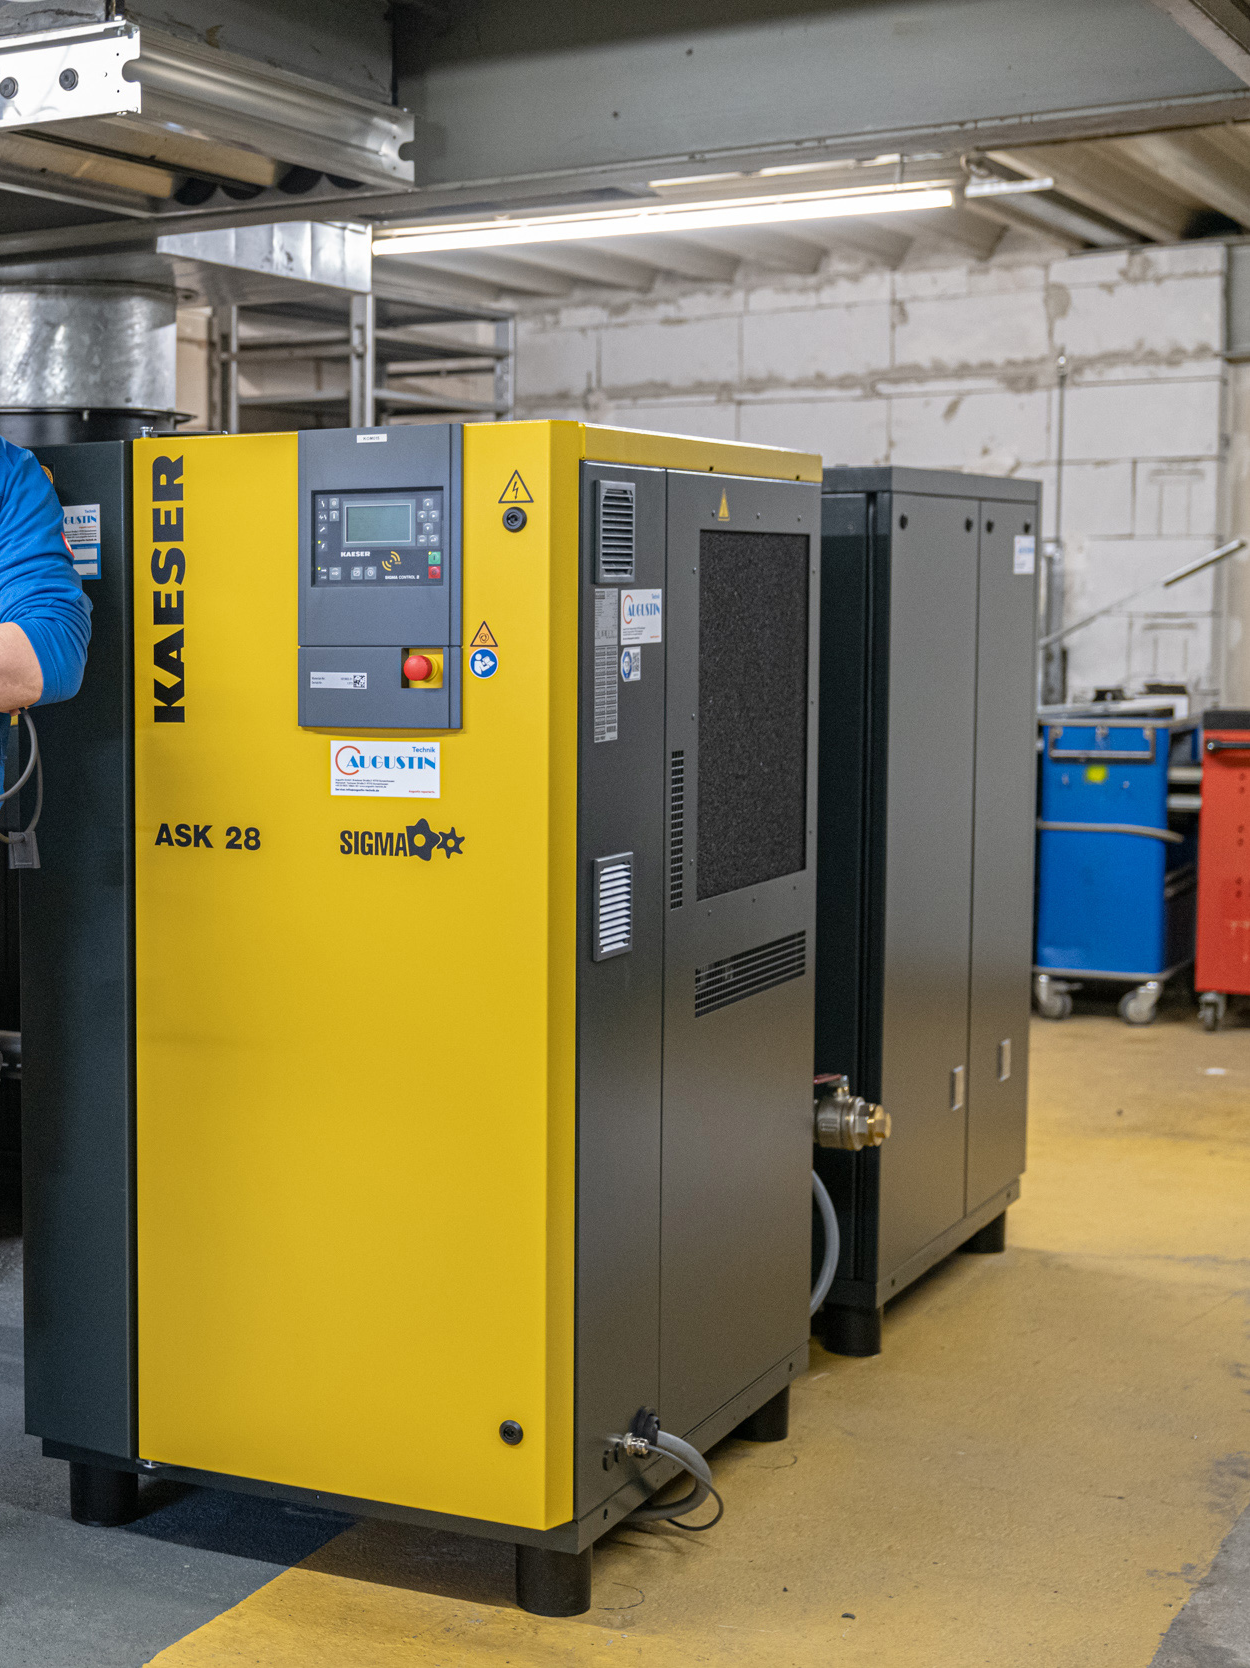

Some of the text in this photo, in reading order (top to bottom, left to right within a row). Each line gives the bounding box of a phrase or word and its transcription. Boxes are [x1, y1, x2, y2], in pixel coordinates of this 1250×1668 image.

[64, 515, 97, 525] GUSTIN
[151, 454, 186, 723] KAESER
[346, 755, 436, 770] AUGUSTIN
[154, 823, 261, 850] ASK 28
[340, 830, 408, 857] SIGMA
